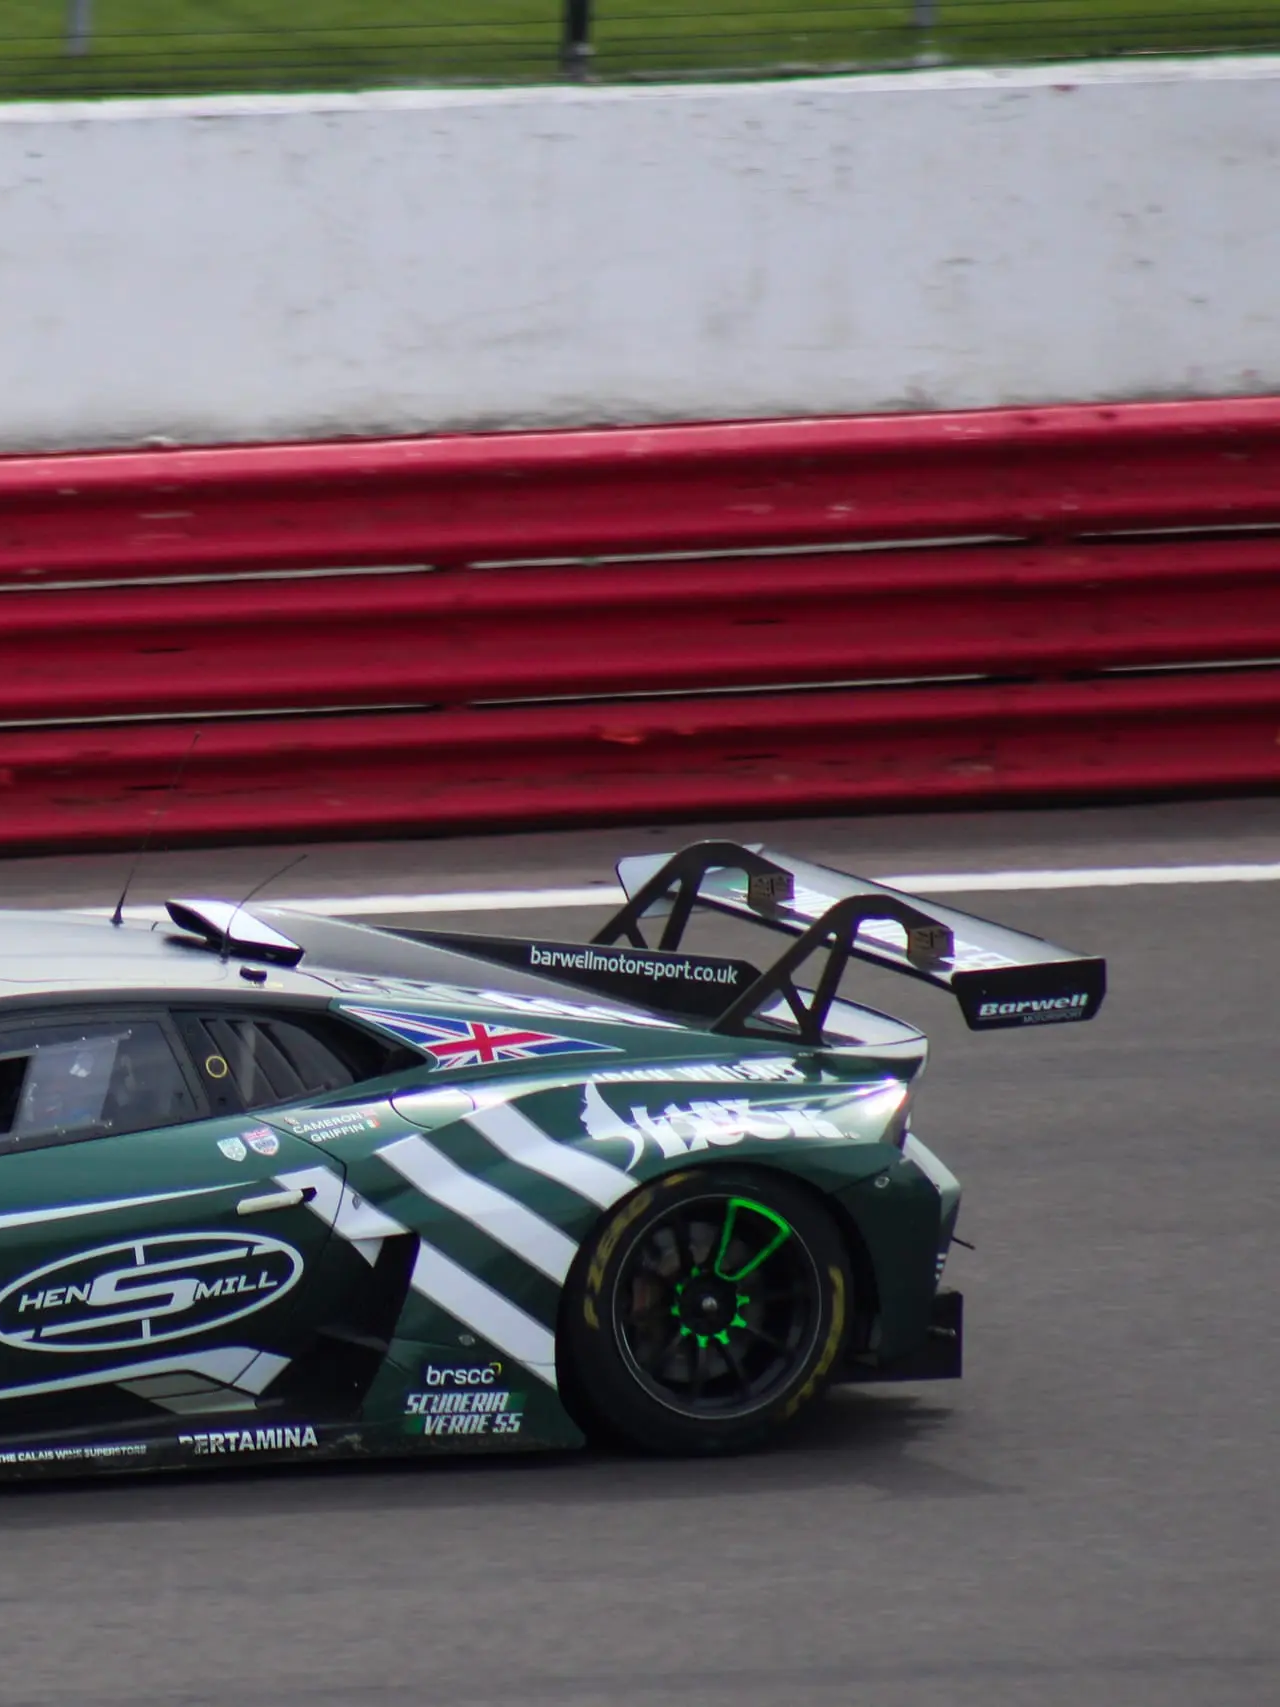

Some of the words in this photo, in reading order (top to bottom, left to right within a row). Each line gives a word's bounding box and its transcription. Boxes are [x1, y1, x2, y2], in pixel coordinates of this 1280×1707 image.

[529, 945, 739, 985] barwellmotorsport.co.uk
[979, 992, 1089, 1017] Barwell
[292, 1110, 363, 1135] CAMERON
[310, 1122, 366, 1143] GRIFFIN
[426, 1364, 495, 1386] brscc
